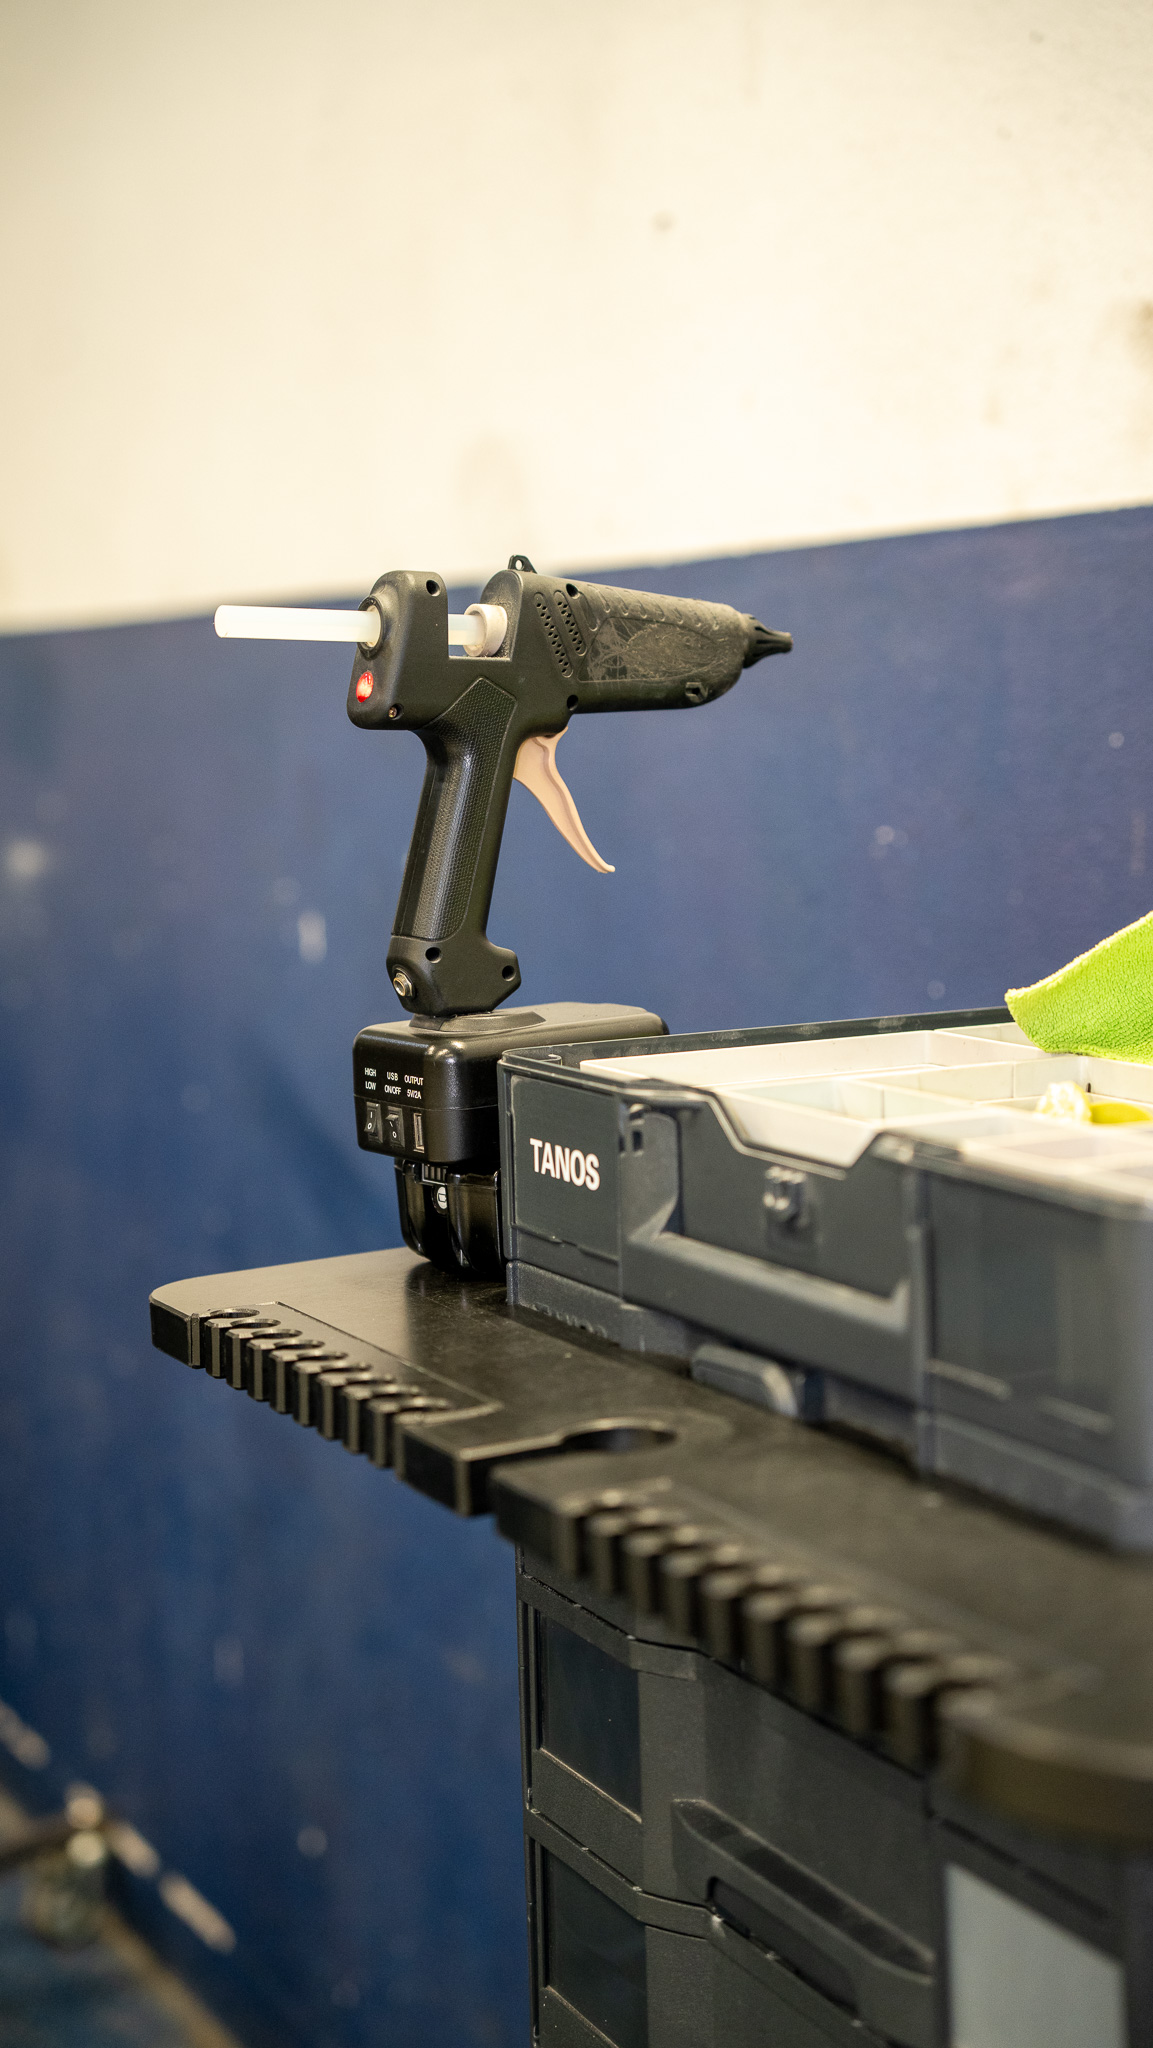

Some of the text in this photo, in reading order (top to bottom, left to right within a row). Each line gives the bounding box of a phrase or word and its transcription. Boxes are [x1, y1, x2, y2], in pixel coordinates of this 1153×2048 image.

[364, 1067, 377, 1077] HIGH
[386, 1071, 399, 1081] USB
[404, 1074, 424, 1086] OUTPUT
[365, 1081, 377, 1091] LOW
[384, 1084, 402, 1095] ON/OFF
[529, 1137, 600, 1191] TANOS
